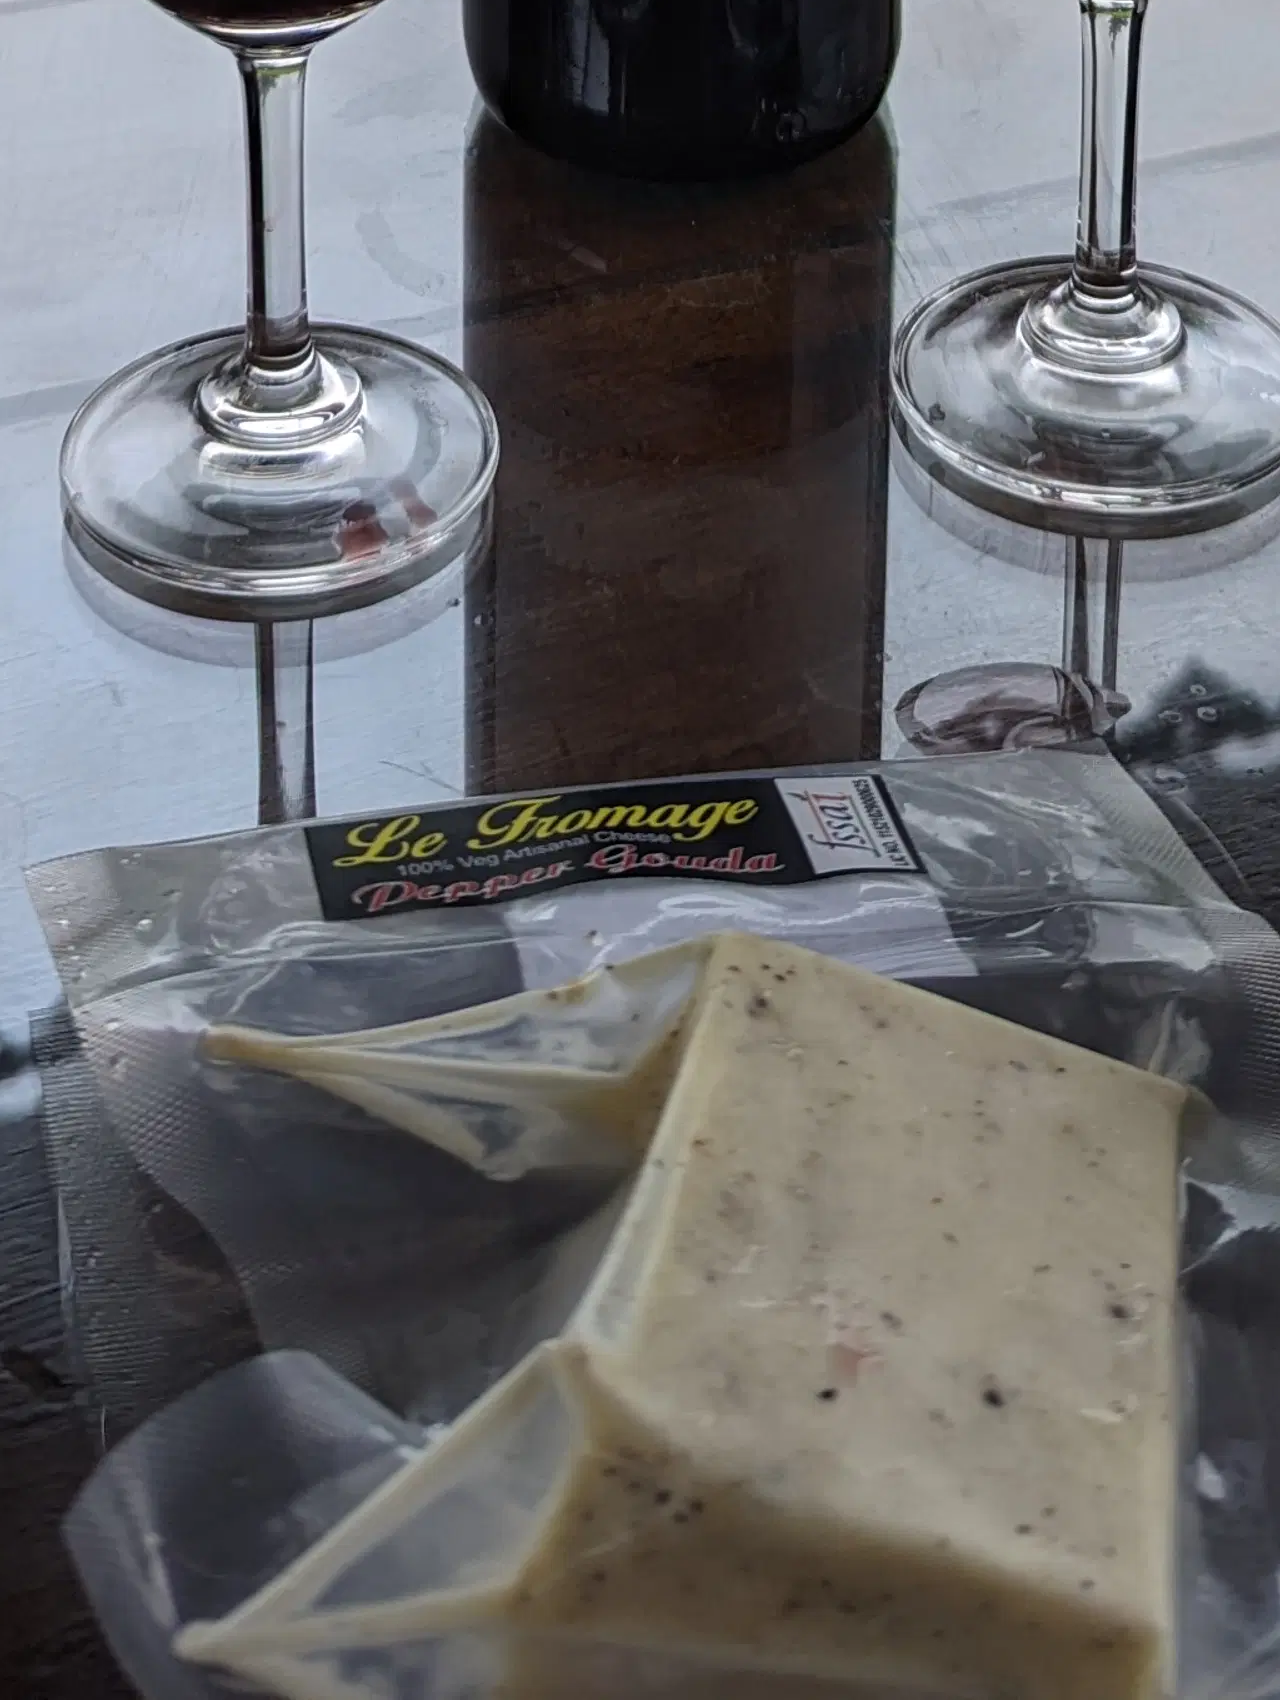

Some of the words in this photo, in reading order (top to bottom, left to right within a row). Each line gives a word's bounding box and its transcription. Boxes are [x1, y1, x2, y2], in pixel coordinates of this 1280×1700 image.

[332, 815, 448, 867] Le
[466, 795, 759, 850] Fromage
[397, 859, 454, 877] 100%
[456, 854, 500, 869] Veg
[503, 833, 590, 862] Artisanal
[593, 830, 671, 844] Cheese
[351, 860, 575, 913] Pepper
[584, 843, 786, 875] Gouda
